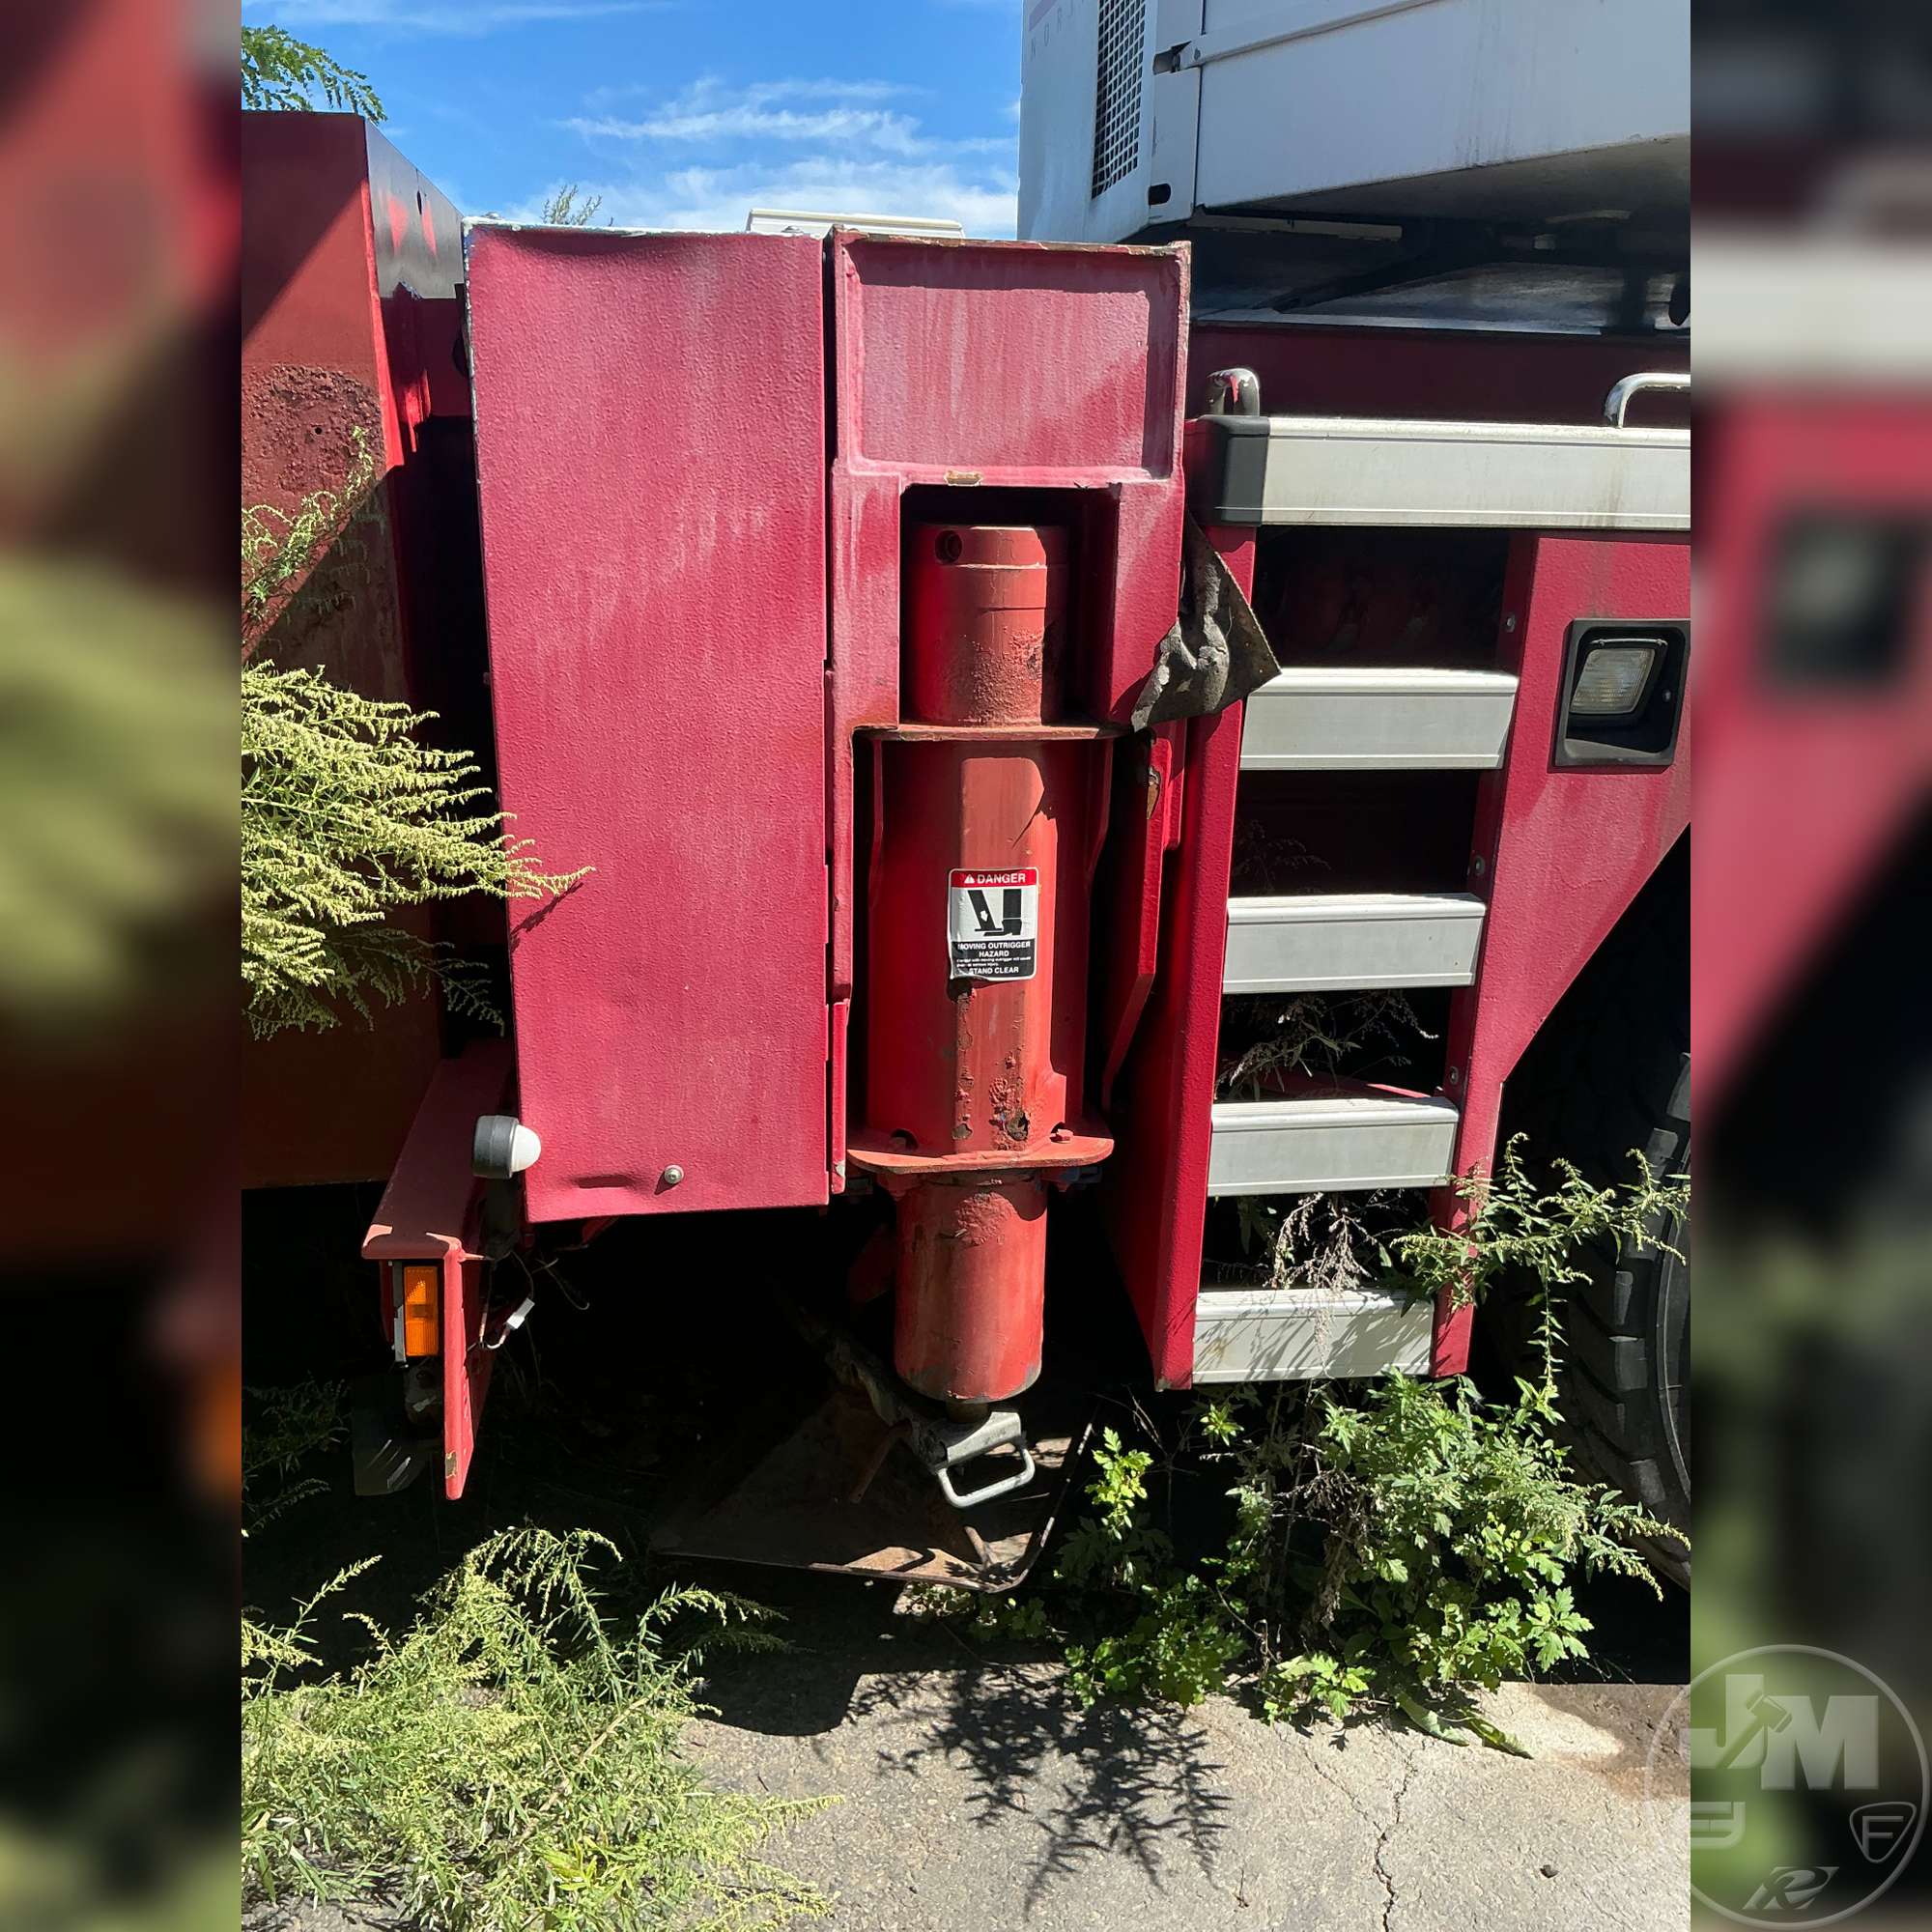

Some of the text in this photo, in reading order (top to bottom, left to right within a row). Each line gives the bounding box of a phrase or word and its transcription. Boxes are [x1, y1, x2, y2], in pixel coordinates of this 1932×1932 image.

[977, 873, 1026, 884] DANGER
[957, 941, 1031, 951] MOVING OUTRIGGER
